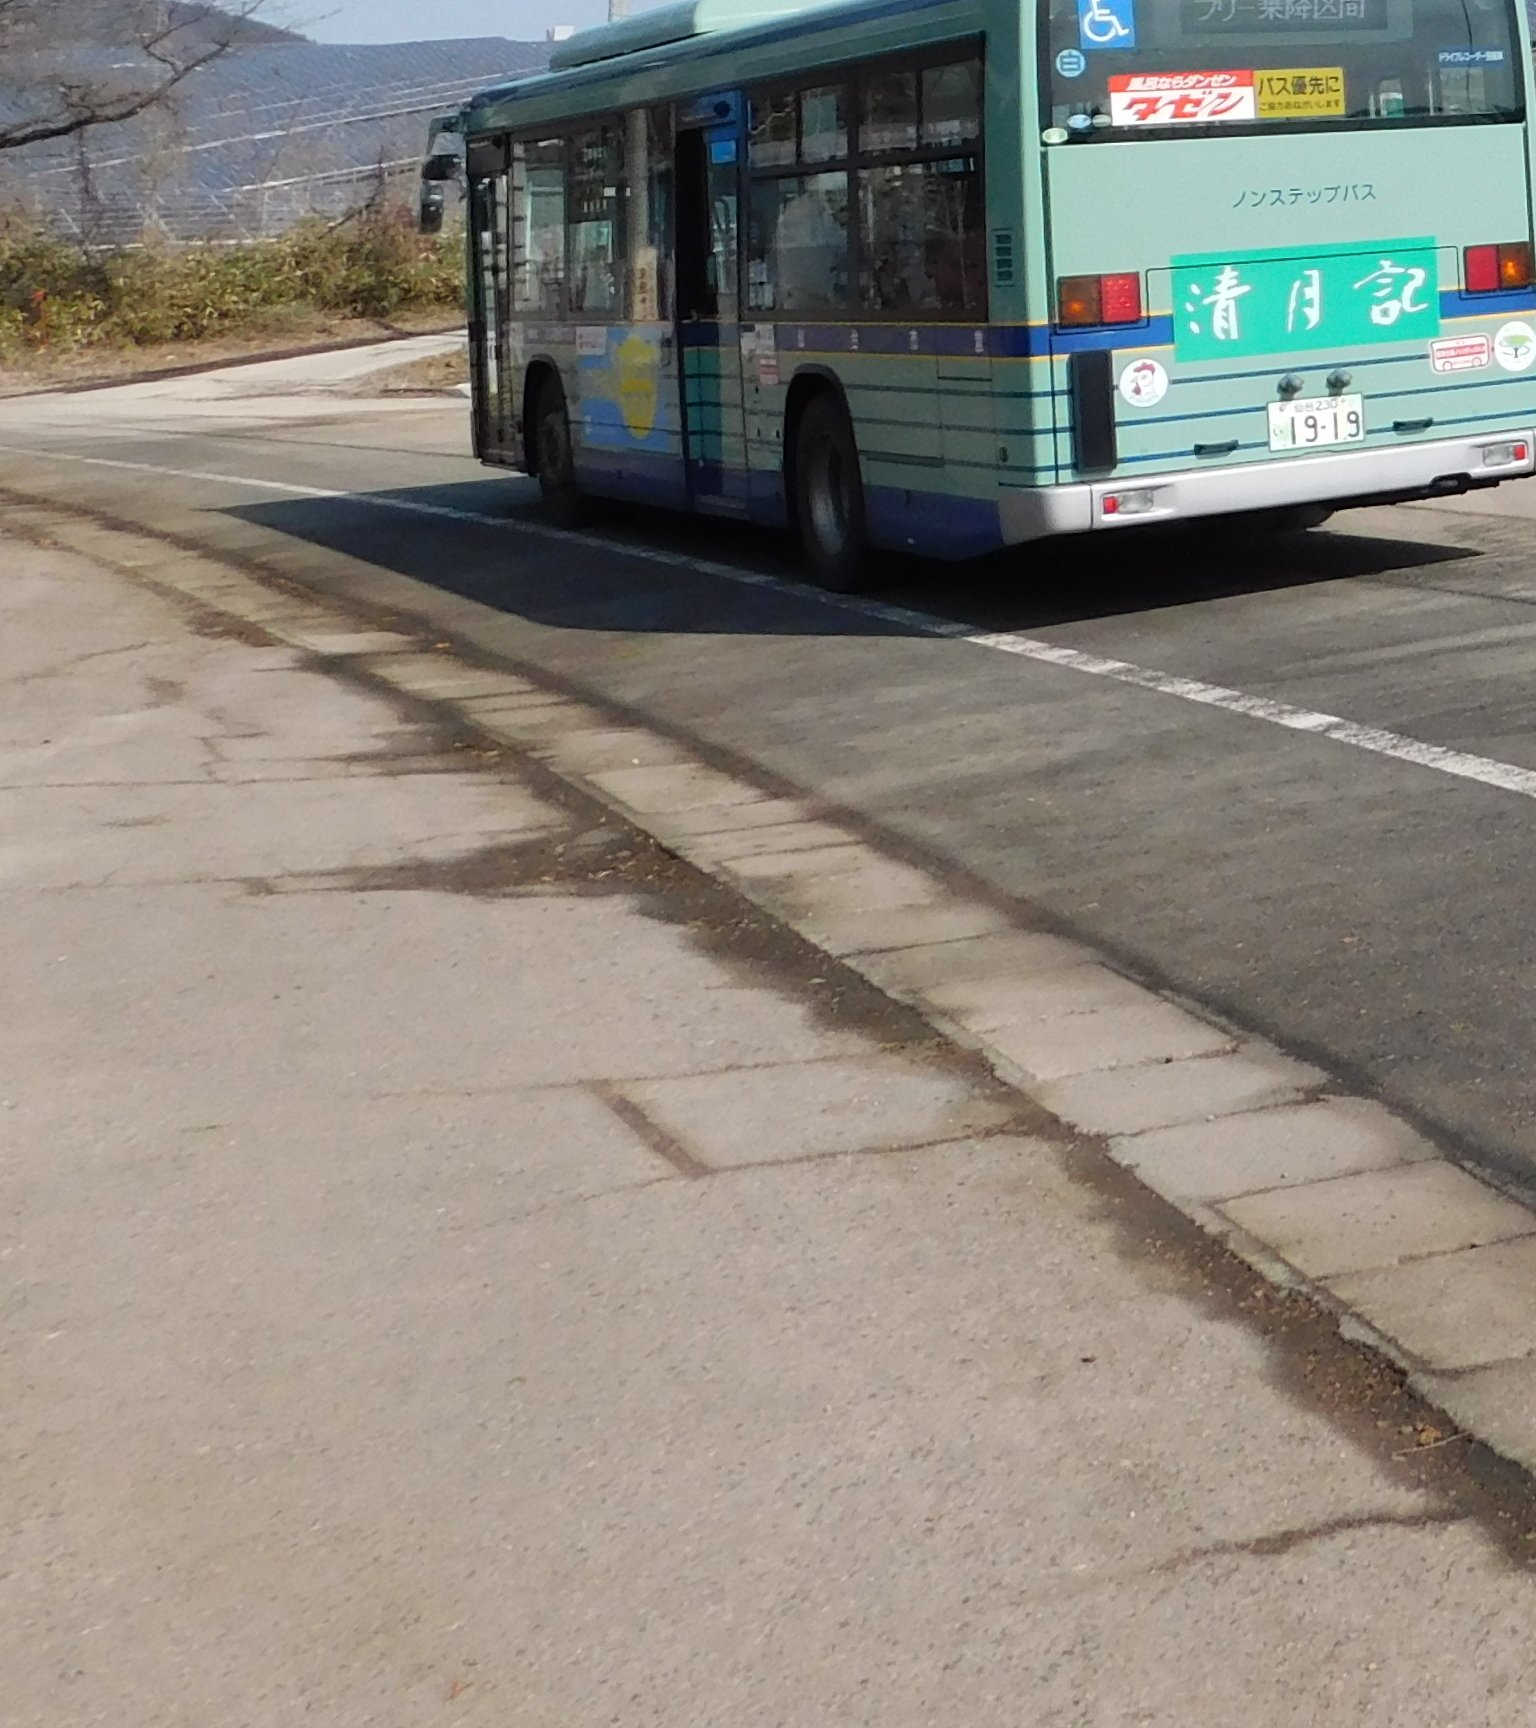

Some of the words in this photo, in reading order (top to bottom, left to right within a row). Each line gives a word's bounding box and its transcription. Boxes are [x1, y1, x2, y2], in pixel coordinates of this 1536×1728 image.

[1258, 76, 1340, 95] バス優先に
[1122, 90, 1244, 121] タゼン
[1233, 184, 1376, 208] ノンステップバス
[1185, 260, 1428, 340] 清月記
[1291, 411, 1360, 445] 19-19
